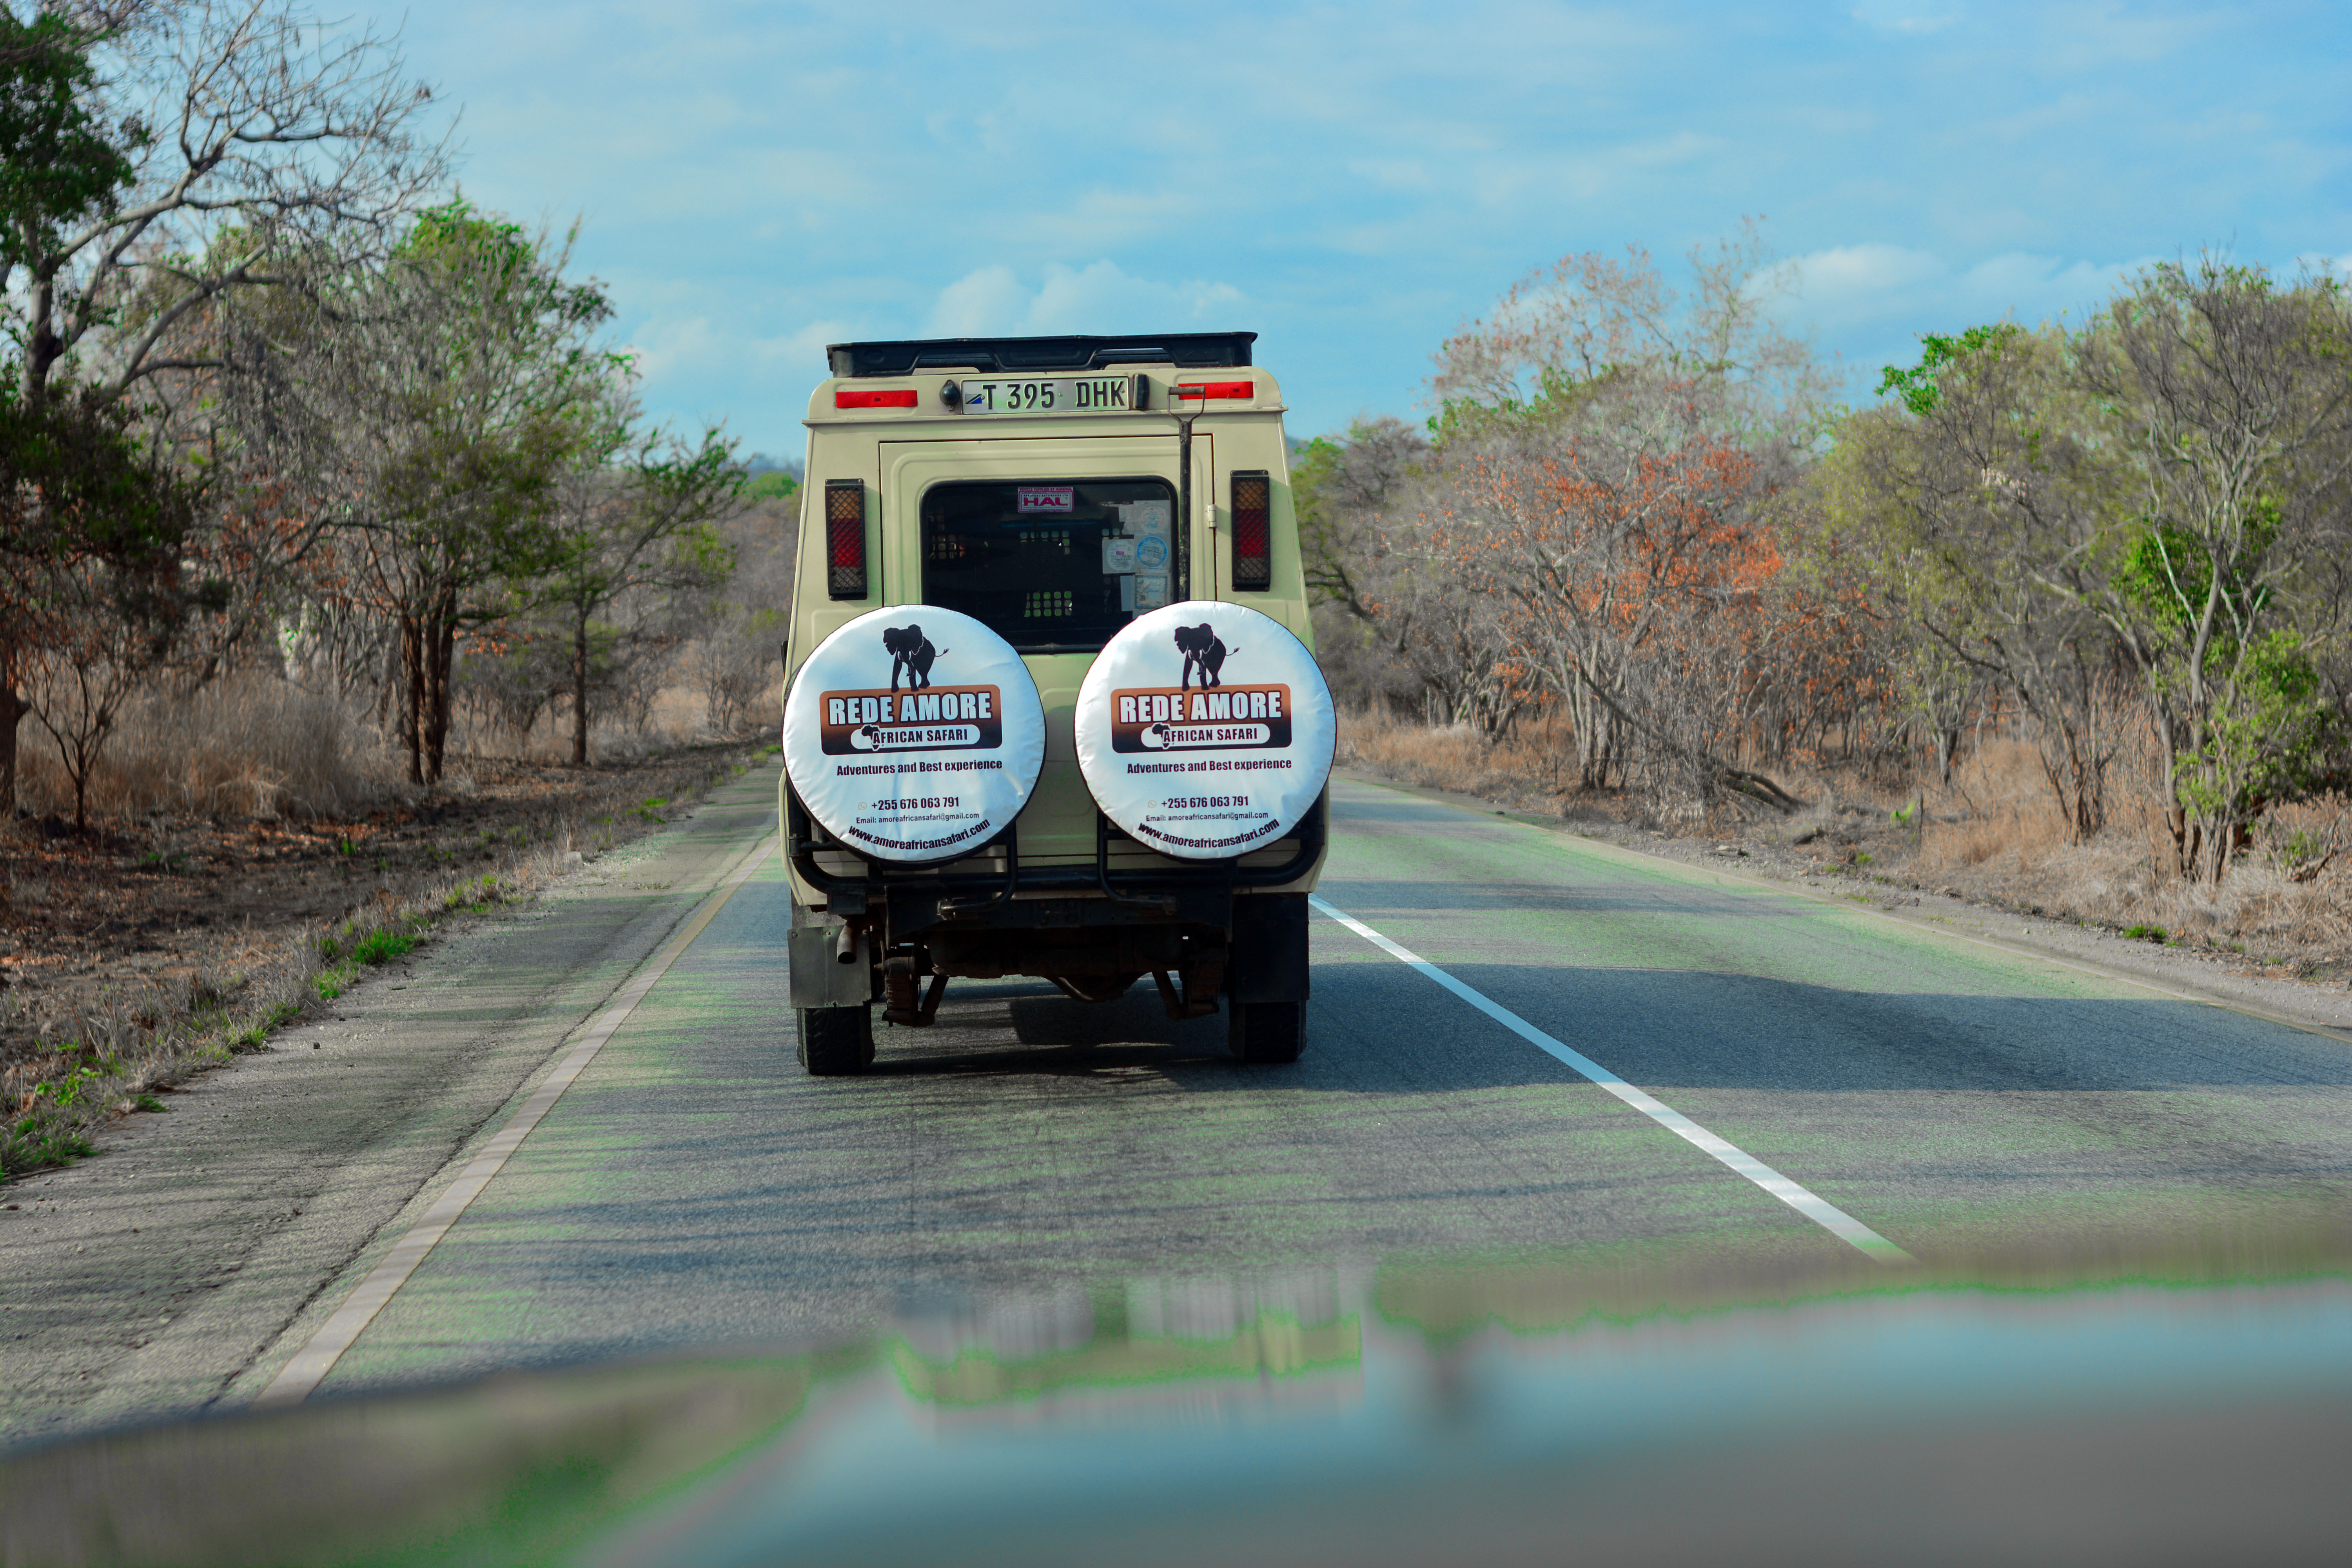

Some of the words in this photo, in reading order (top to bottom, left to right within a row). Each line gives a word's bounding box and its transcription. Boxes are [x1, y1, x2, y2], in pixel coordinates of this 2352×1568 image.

[983, 385, 996, 410] T
[1007, 383, 1054, 409] 395
[1075, 381, 1125, 407] DHK
[1024, 497, 1068, 506] HAL
[829, 696, 893, 725] REDE
[900, 693, 991, 722] AMORE
[1119, 695, 1184, 723] REDE
[1191, 691, 1281, 721] AMORE
[873, 730, 922, 744] AFRICAN
[927, 729, 967, 741] SAFARI
[1163, 729, 1213, 742] AFRICAN
[1217, 728, 1258, 740] SAFARI
[837, 764, 895, 776] Adventures
[898, 762, 916, 773] and
[919, 761, 942, 772] Best
[945, 760, 1002, 771] experience
[1127, 763, 1185, 774] Adventures
[1188, 761, 1206, 772] and
[1209, 760, 1232, 771] Best
[1234, 759, 1292, 771] experience
[871, 799, 897, 810] +255
[900, 798, 918, 809] 676
[921, 797, 940, 808] 063
[942, 797, 959, 807] 791
[1161, 798, 1187, 809] +255
[1190, 797, 1207, 808] 676
[1210, 796, 1230, 807] 063
[1232, 796, 1249, 806] 791
[878, 812, 979, 823] amoreafricansafari@gmail.com
[1168, 811, 1269, 821] amoreafricansafari@gmail.com
[848, 819, 990, 850] www.amoreafricansafari.com
[1138, 818, 1279, 848] www.amoreafricansafari.com
